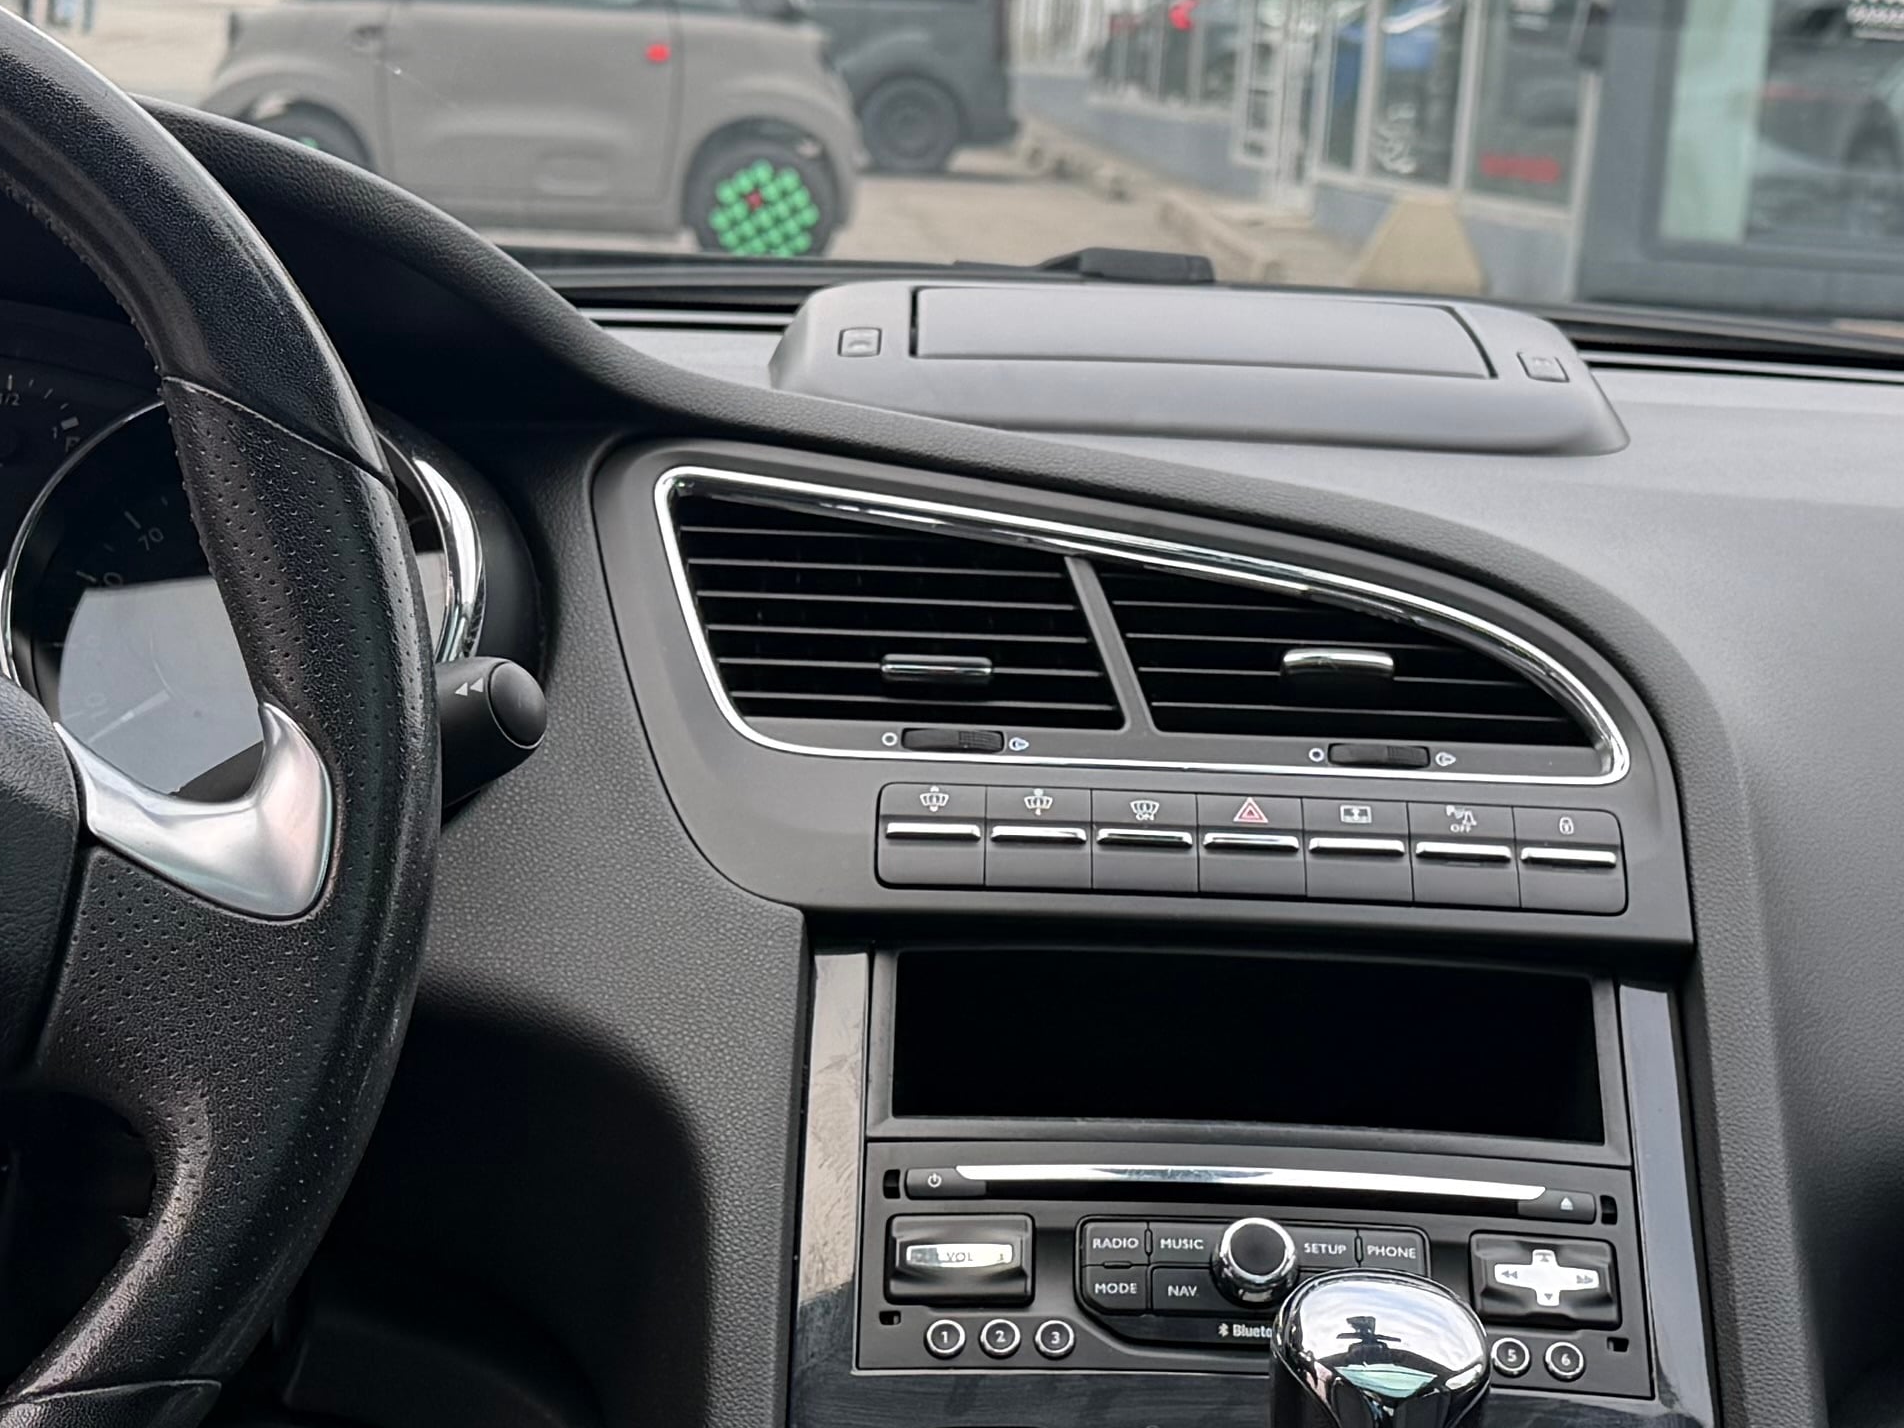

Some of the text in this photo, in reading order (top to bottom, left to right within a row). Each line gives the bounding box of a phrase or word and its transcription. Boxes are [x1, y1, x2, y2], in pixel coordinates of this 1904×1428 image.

[137, 527, 165, 551] 70
[1092, 1236, 1139, 1250] RADIO
[1159, 1237, 1204, 1251] MUSIC
[1303, 1242, 1347, 1256] SETUP
[946, 1251, 975, 1262] VOL
[1366, 1244, 1417, 1260] PHONE
[1094, 1281, 1138, 1295] MODE
[1167, 1284, 1198, 1297] NAV
[940, 1330, 949, 1343] 1
[995, 1329, 1006, 1343] 2
[1050, 1330, 1061, 1344] 3
[1232, 1323, 1273, 1338] Blueto
[1506, 1348, 1517, 1363] 5
[1561, 1353, 1572, 1367] 6
